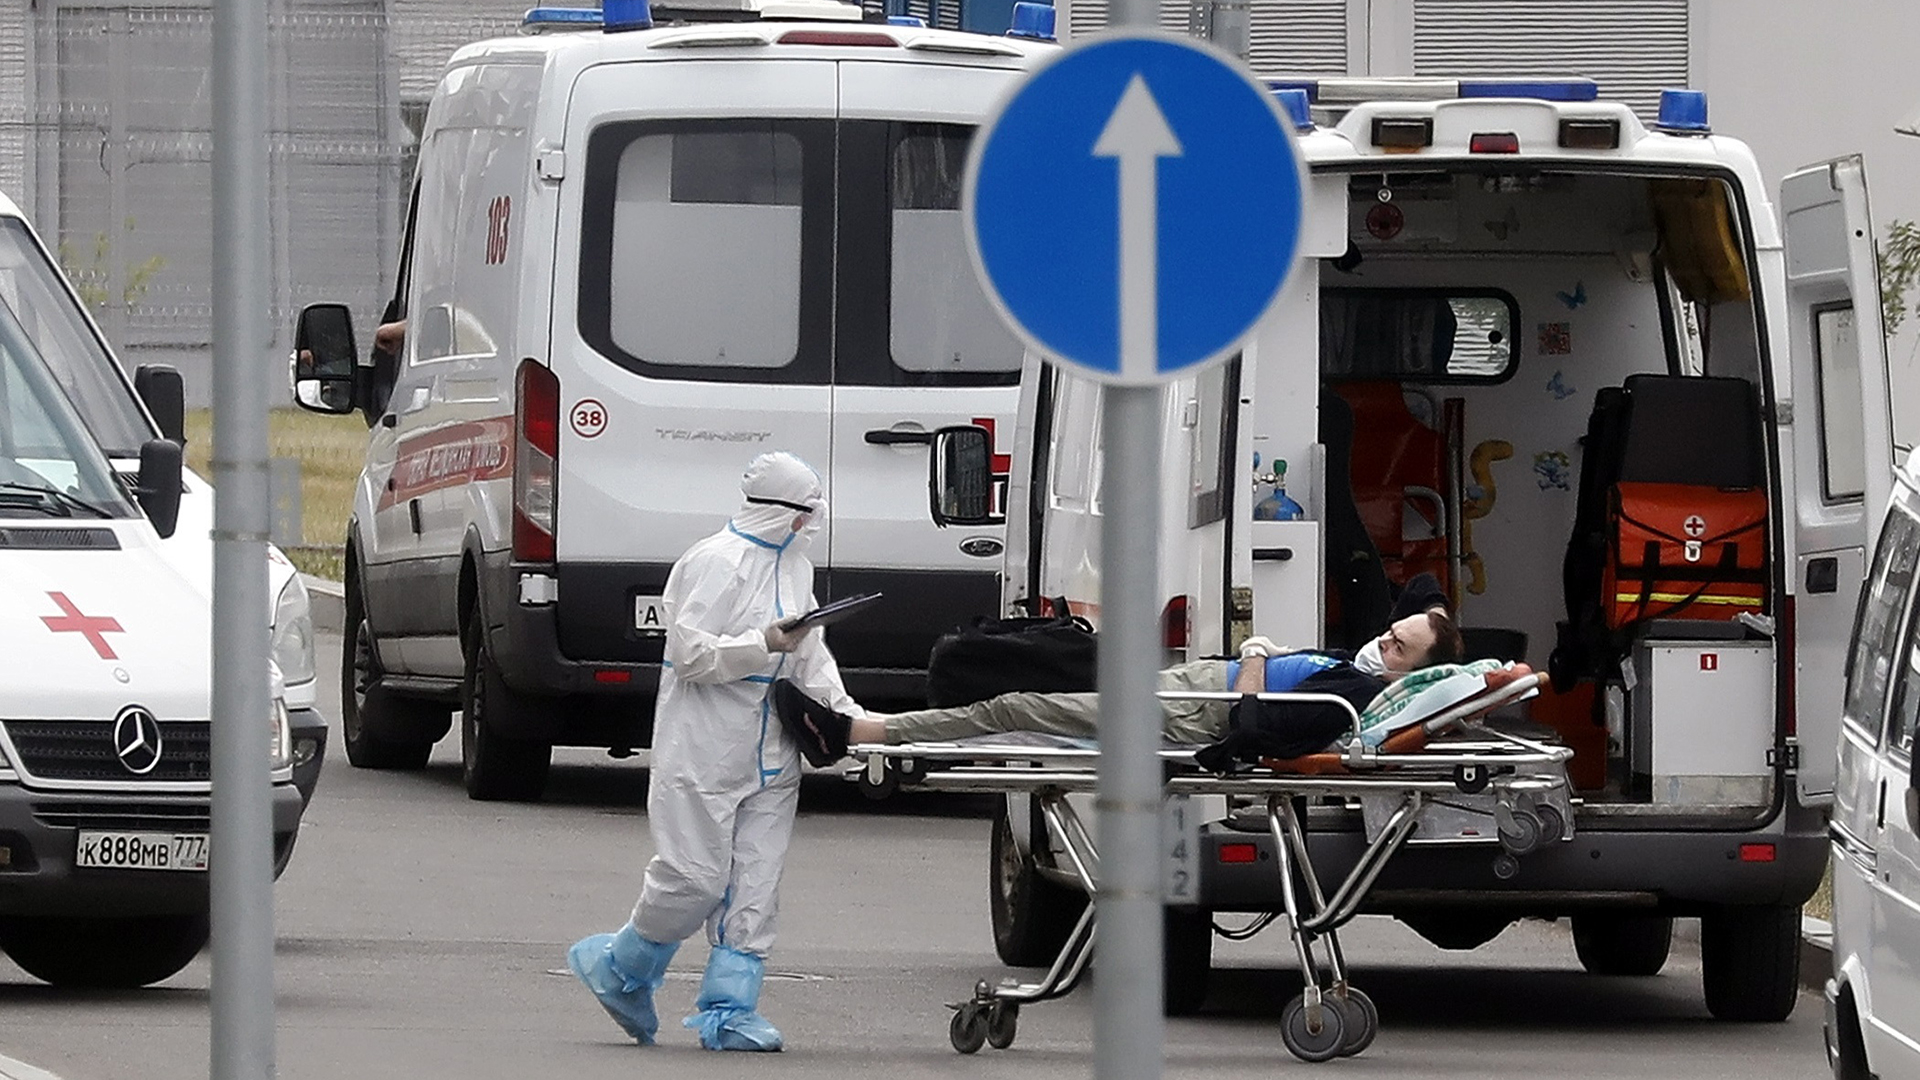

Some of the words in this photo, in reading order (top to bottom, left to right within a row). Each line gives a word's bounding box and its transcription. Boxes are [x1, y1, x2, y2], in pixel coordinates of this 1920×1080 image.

[485, 195, 511, 265] 103
[576, 411, 602, 427] 38
[174, 837, 205, 858] 777
